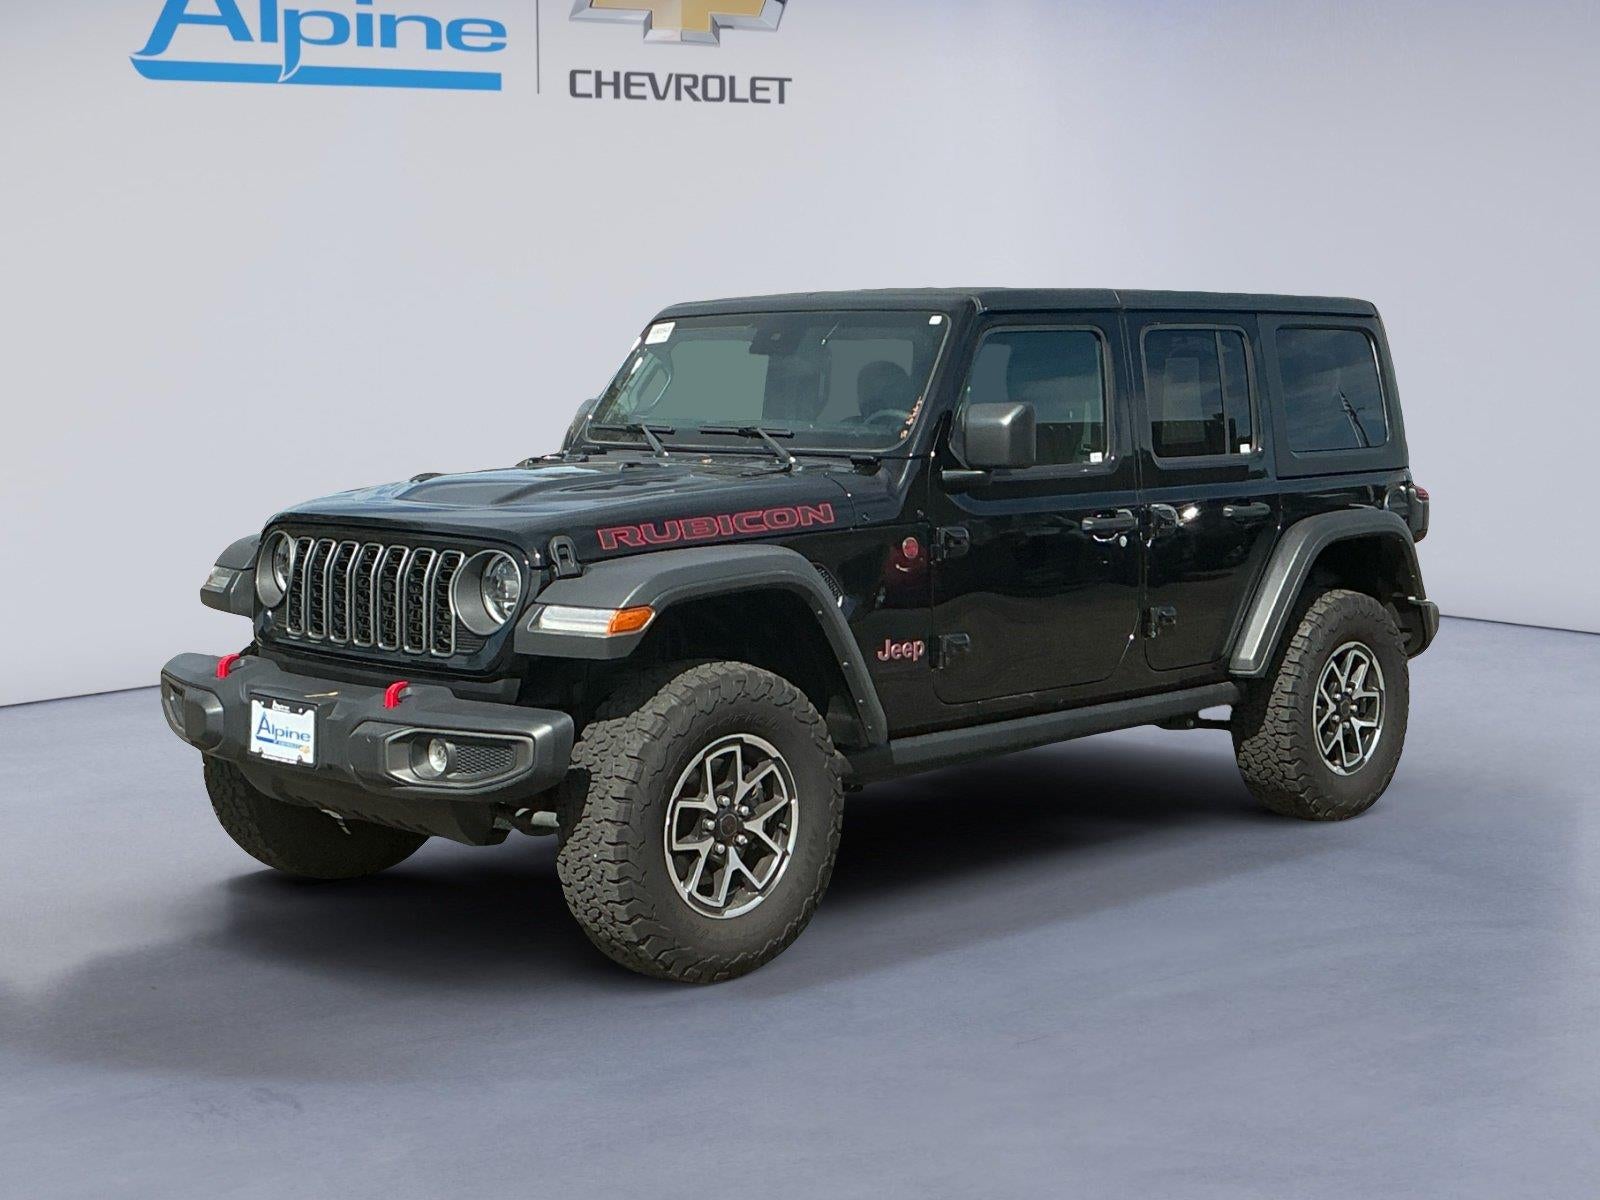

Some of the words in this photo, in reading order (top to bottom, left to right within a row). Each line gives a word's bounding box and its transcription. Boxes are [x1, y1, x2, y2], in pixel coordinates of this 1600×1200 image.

[569, 69, 793, 104] CHEVROLET
[597, 503, 834, 550] RUBICON
[877, 638, 925, 662] Jeep
[256, 711, 311, 743] Alpine
